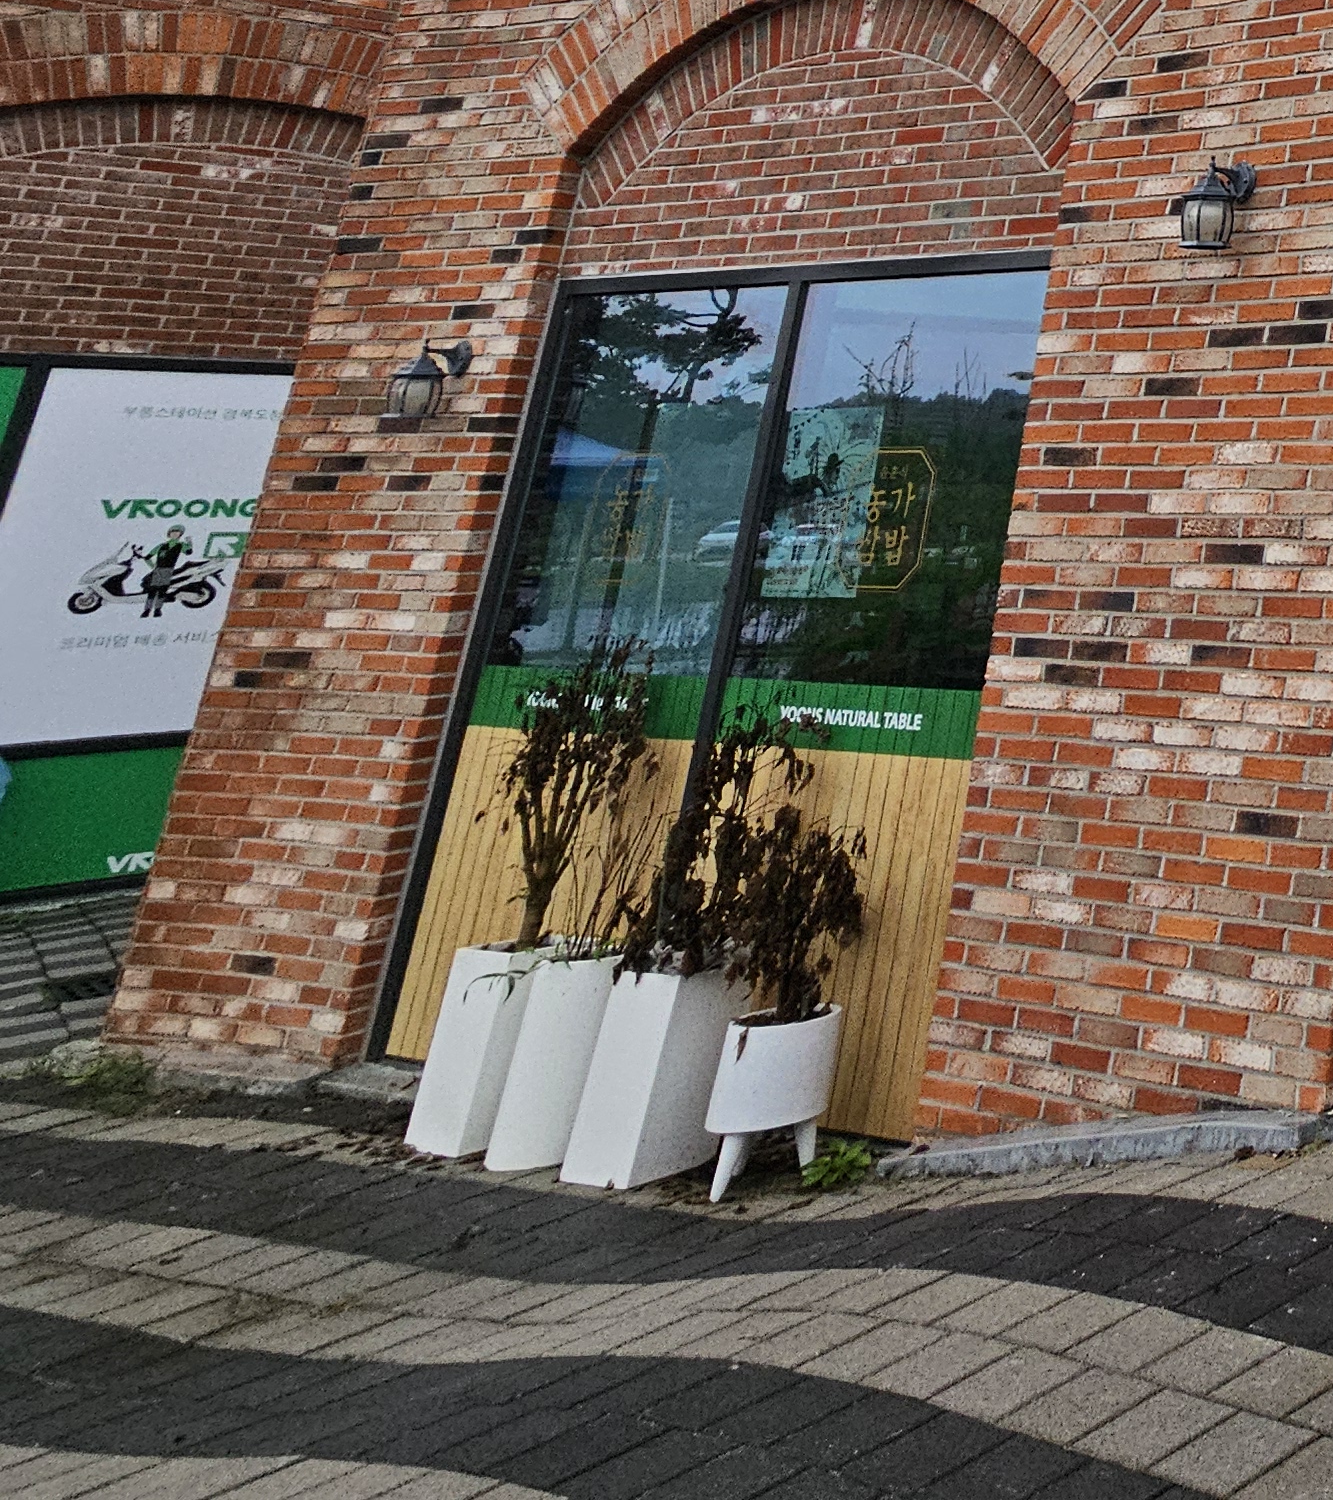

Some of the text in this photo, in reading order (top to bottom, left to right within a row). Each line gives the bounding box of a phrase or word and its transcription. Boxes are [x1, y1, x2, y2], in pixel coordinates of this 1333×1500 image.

[101, 498, 259, 520] VROONG
[824, 708, 881, 729] NATURAL
[883, 711, 923, 731] TABLE
